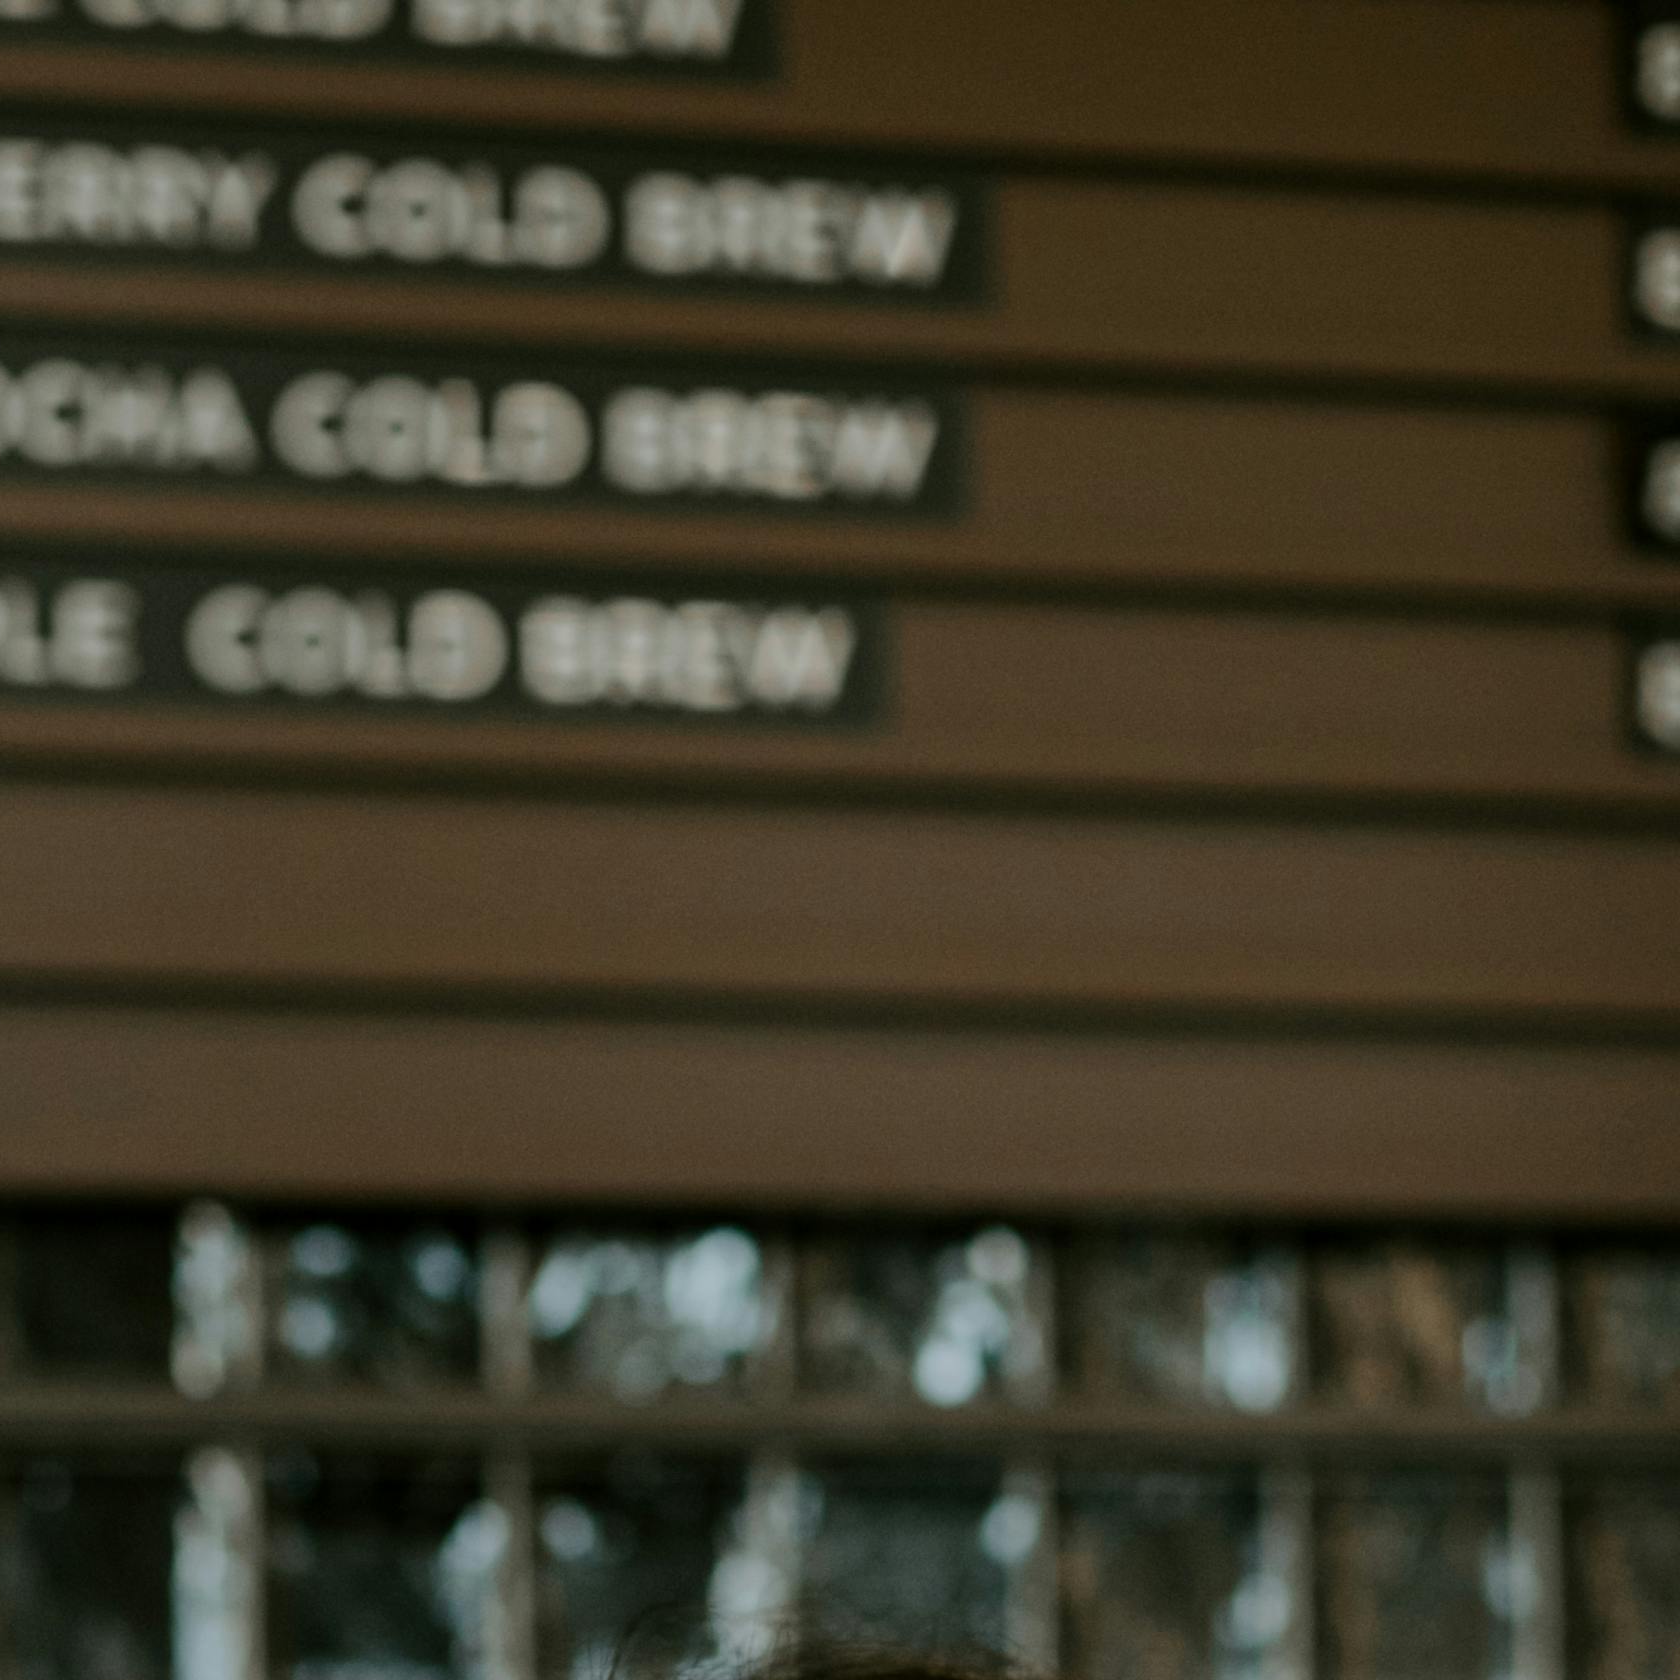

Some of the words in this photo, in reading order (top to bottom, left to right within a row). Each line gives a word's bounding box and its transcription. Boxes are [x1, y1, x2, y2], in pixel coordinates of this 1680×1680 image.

[291, 153, 611, 269] COLD
[621, 171, 956, 288] BREW
[270, 370, 592, 488] COLD
[600, 386, 938, 502] BREW
[184, 583, 509, 702] COLD
[519, 597, 856, 712] BREW
